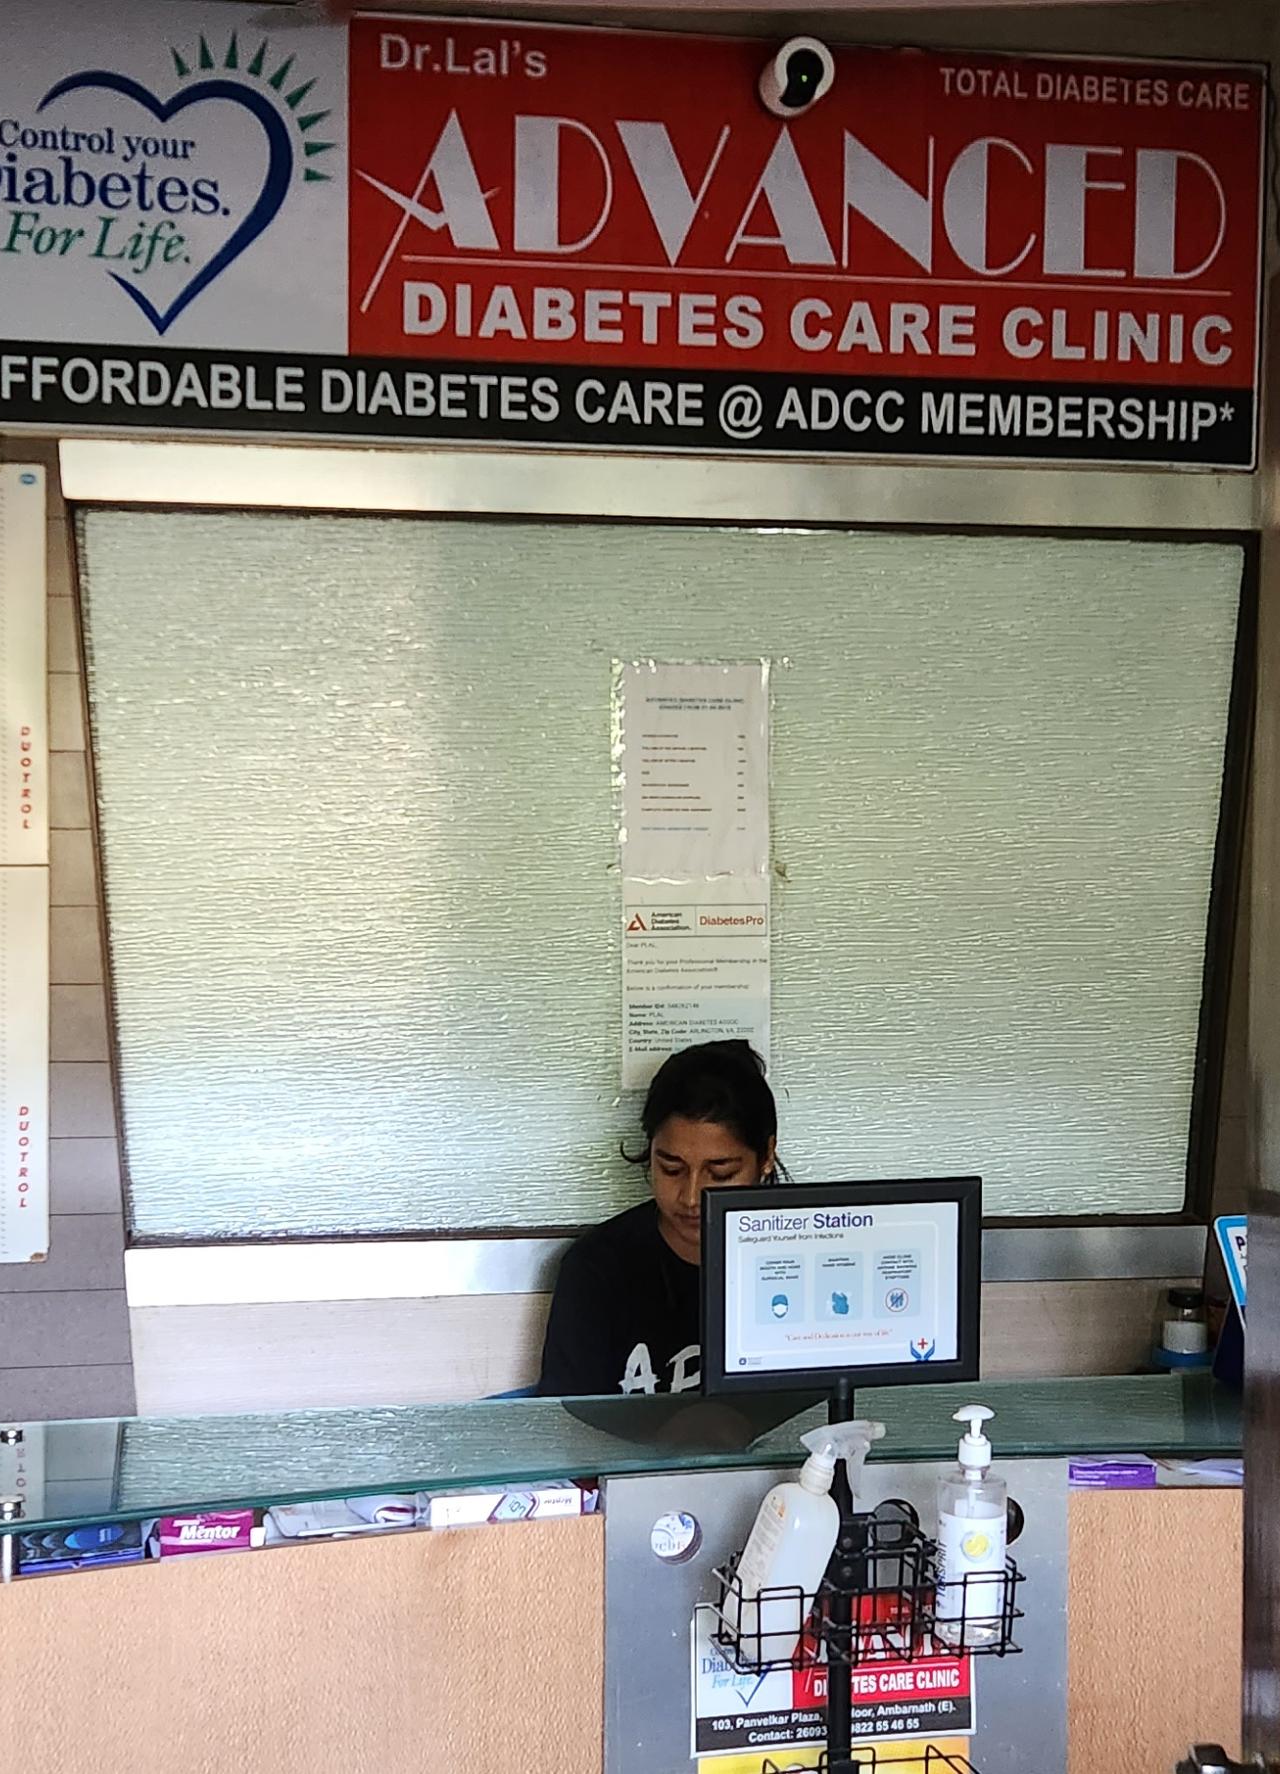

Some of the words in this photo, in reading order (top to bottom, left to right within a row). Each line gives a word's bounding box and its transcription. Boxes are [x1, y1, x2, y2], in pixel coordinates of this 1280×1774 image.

[379, 32, 548, 78] Dr.Lal's
[940, 66, 1028, 100] TOTAL
[1035, 71, 1169, 107] DIABETES
[1177, 79, 1250, 111] CARE
[122, 132, 195, 163] your
[356, 107, 1227, 313] ADVANCED
[0, 210, 85, 257] For
[88, 215, 193, 275] Life.
[402, 281, 765, 349] DIABETES
[790, 297, 977, 357] CARE
[1003, 306, 1234, 366] CLINIC
[321, 368, 559, 422] DIABETES
[574, 379, 705, 428] CARE
[718, 384, 764, 440] @
[776, 385, 906, 433] ADCC
[20, 726, 32, 829] DUOTROL
[18, 1106, 30, 1208] DUOTROL
[738, 1235, 771, 1243] Safeguard
[739, 1215, 809, 1232] Sanitizer
[813, 1212, 873, 1229] Station
[180, 1525, 240, 1541] Mentor
[879, 1672, 914, 1692] CARE
[917, 1669, 960, 1689] CLINIC
[712, 1719, 734, 1732] 103,
[736, 1716, 789, 1729] Panvelkar
[791, 1711, 823, 1725] Plaza,
[852, 1708, 875, 1719] loor,
[877, 1703, 935, 1717] Ambarnath
[938, 1702, 956, 1714] (E).
[748, 1730, 794, 1743] Contact:
